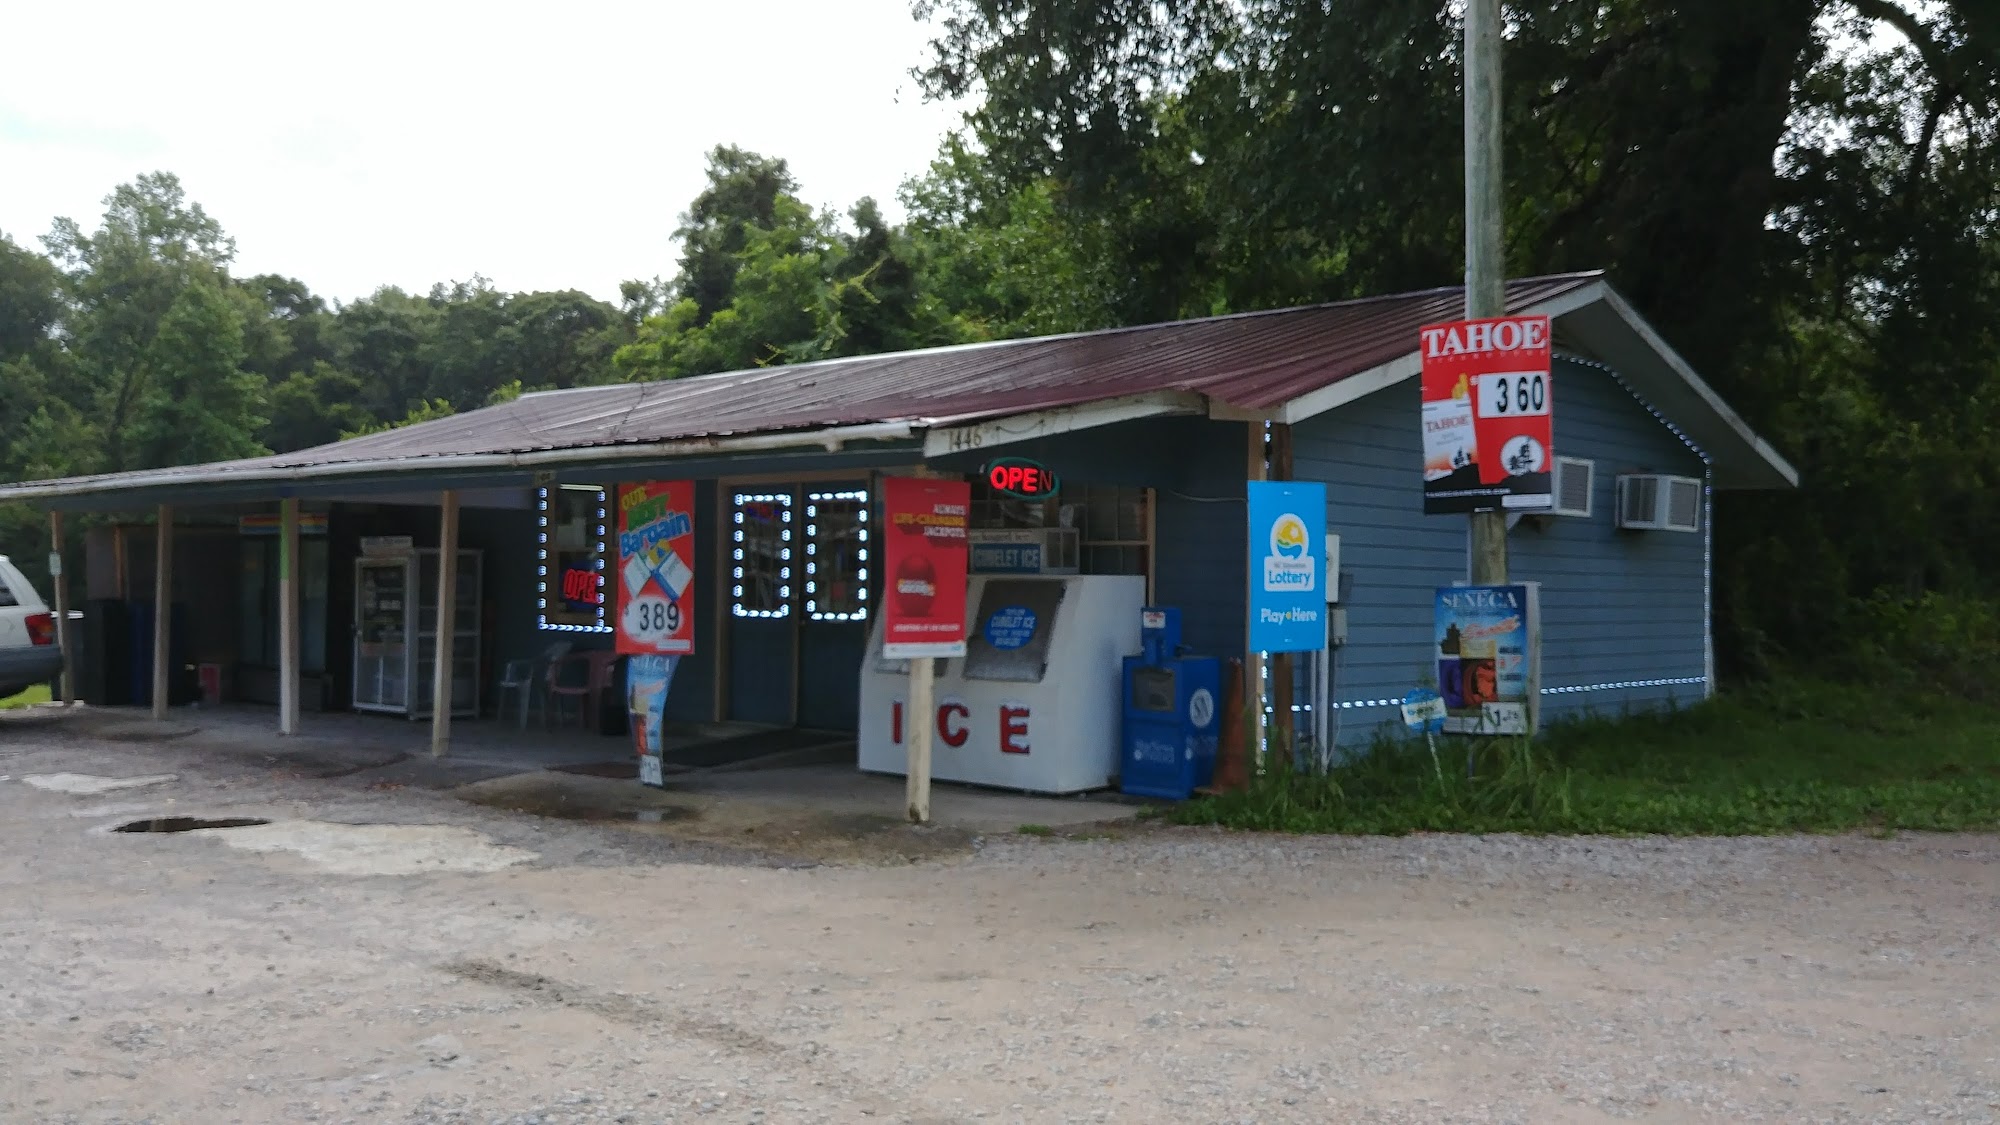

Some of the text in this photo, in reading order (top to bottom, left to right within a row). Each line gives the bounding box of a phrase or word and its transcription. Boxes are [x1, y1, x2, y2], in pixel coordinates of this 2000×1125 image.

[1422, 320, 1548, 358] TAHOE
[1425, 415, 1470, 433] TAHOE
[989, 466, 1053, 492] OPEN
[620, 511, 692, 559] Bargain
[563, 569, 601, 604] OPE
[1268, 571, 1311, 587] Lottery
[1442, 591, 1518, 609] SENECA
[639, 602, 680, 631] 389
[1260, 607, 1317, 625] Play Here
[892, 700, 1031, 755] ICE
